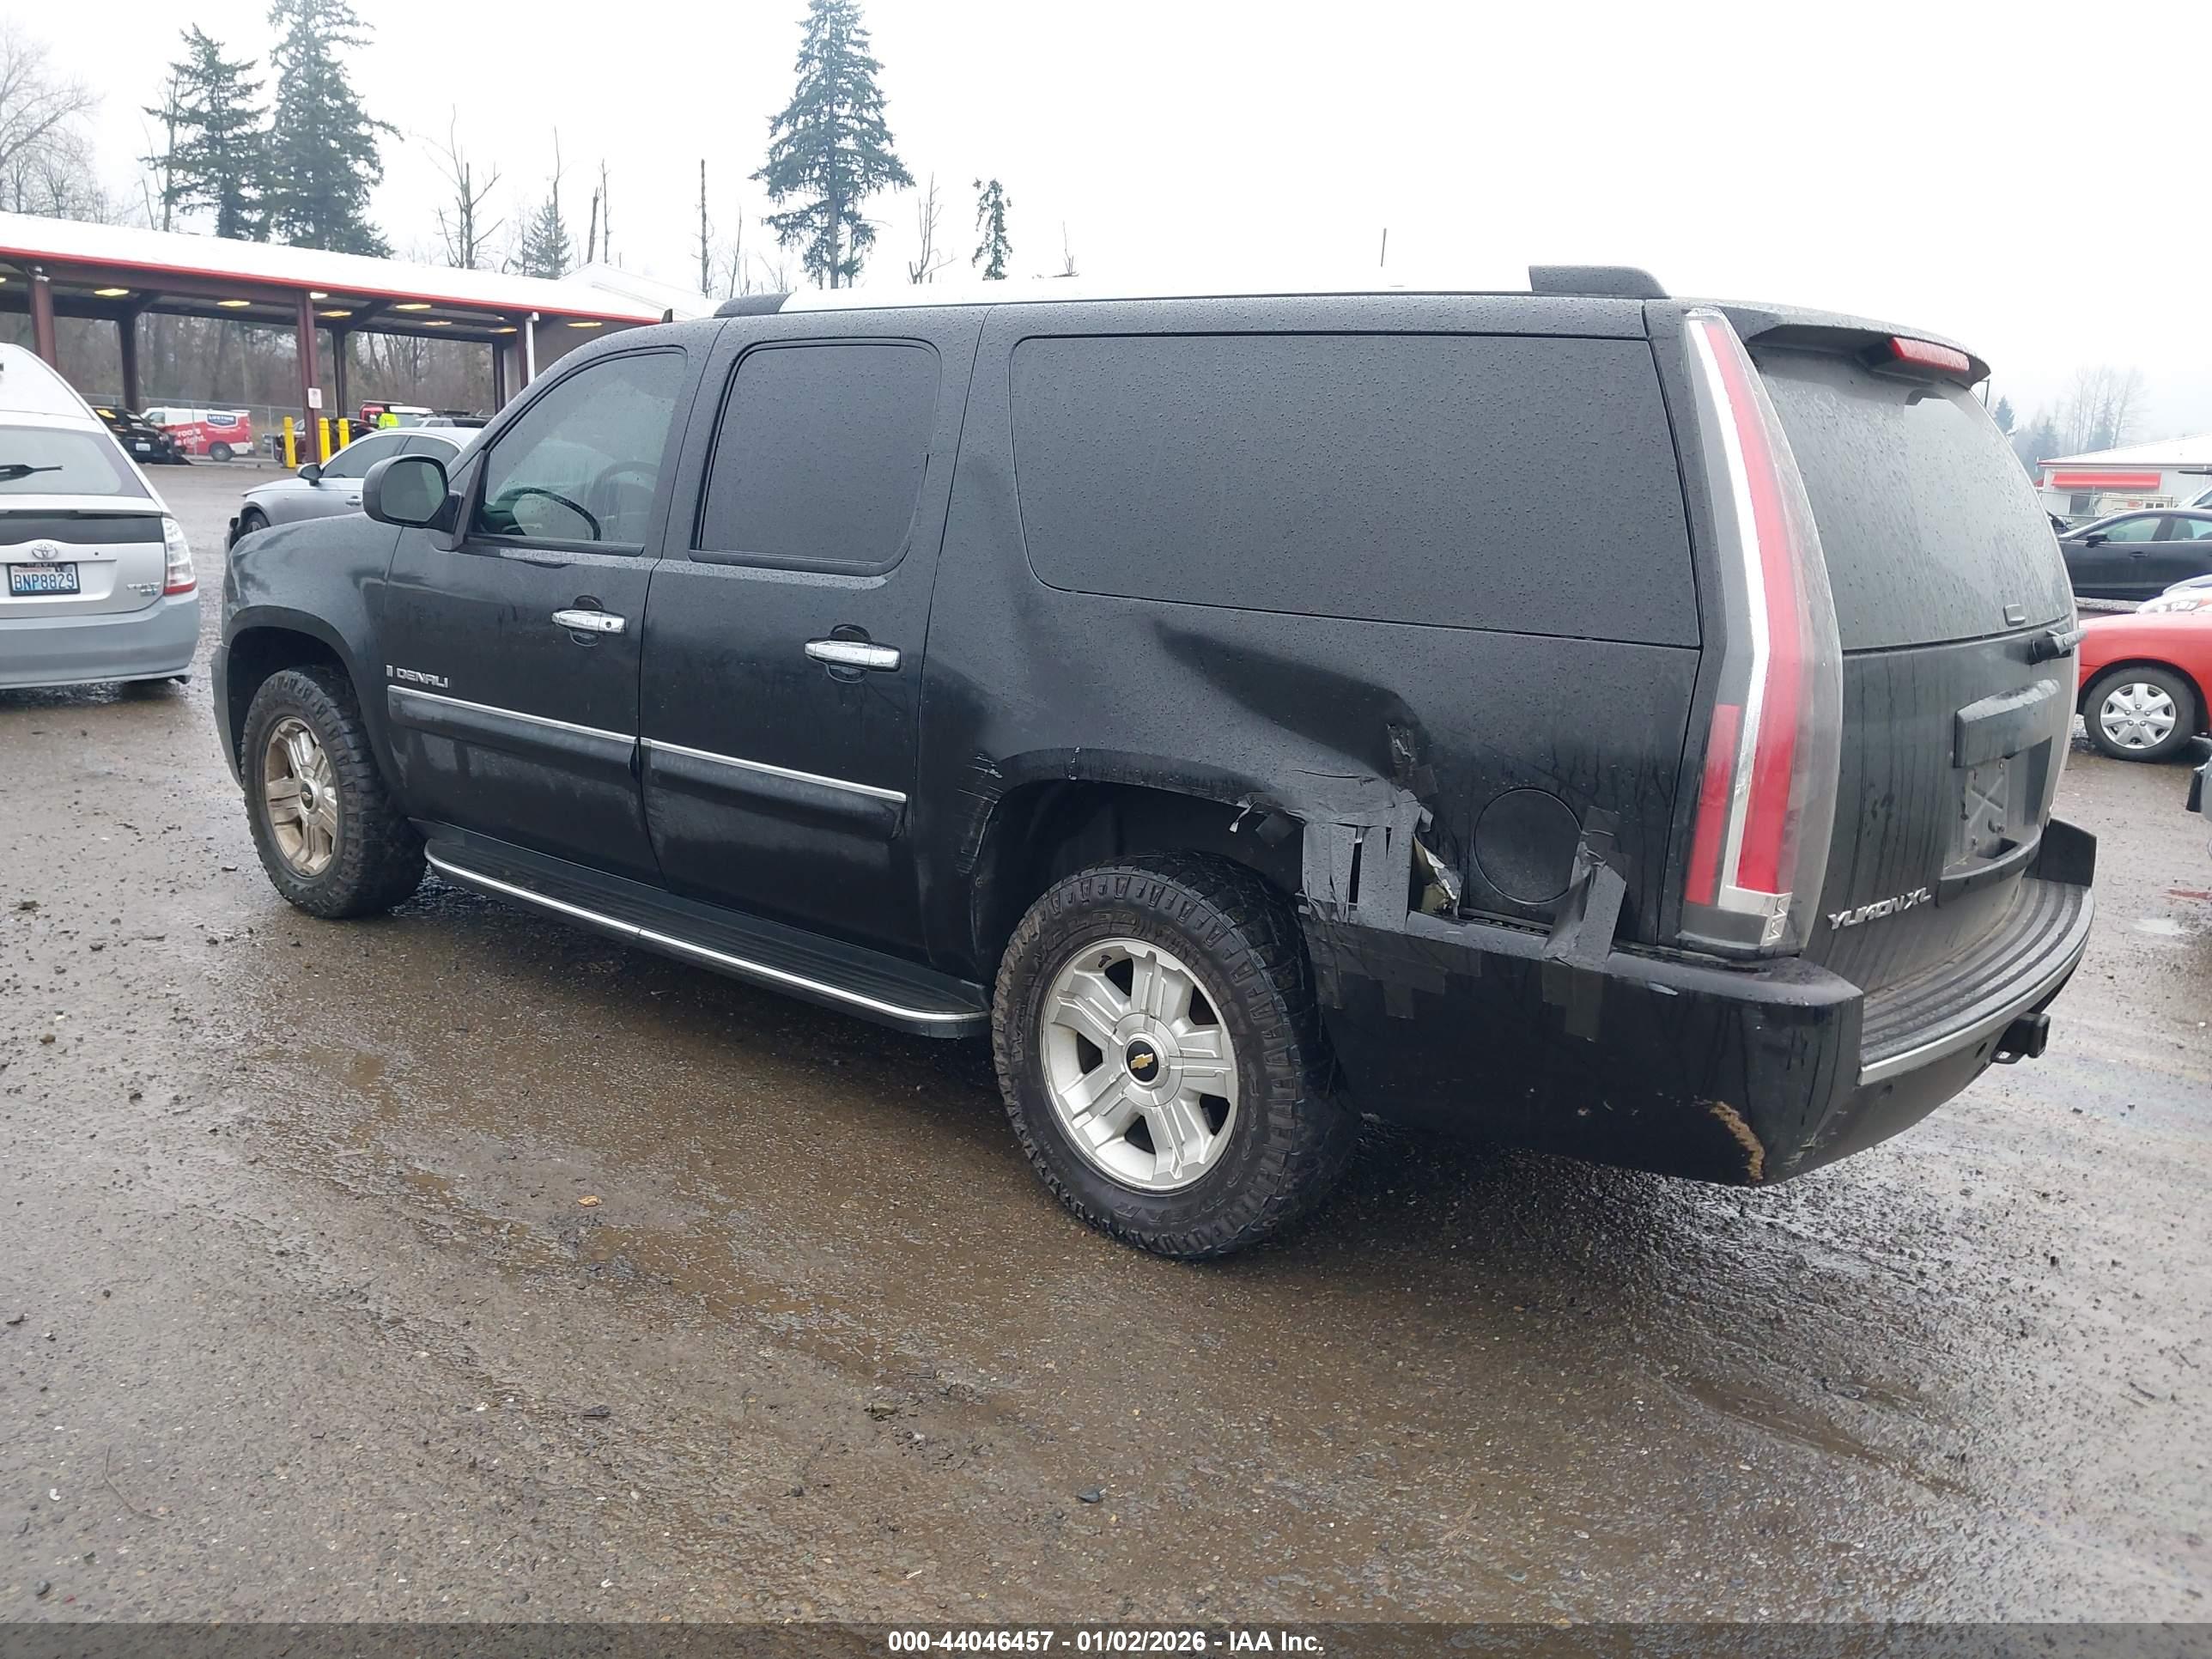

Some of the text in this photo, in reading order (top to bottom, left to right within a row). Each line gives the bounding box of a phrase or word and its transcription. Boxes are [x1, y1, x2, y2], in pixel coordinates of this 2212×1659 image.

[14, 573, 75, 590] BNP8829
[396, 667, 449, 689] DENALI
[1827, 886, 1931, 930] YUKON XL
